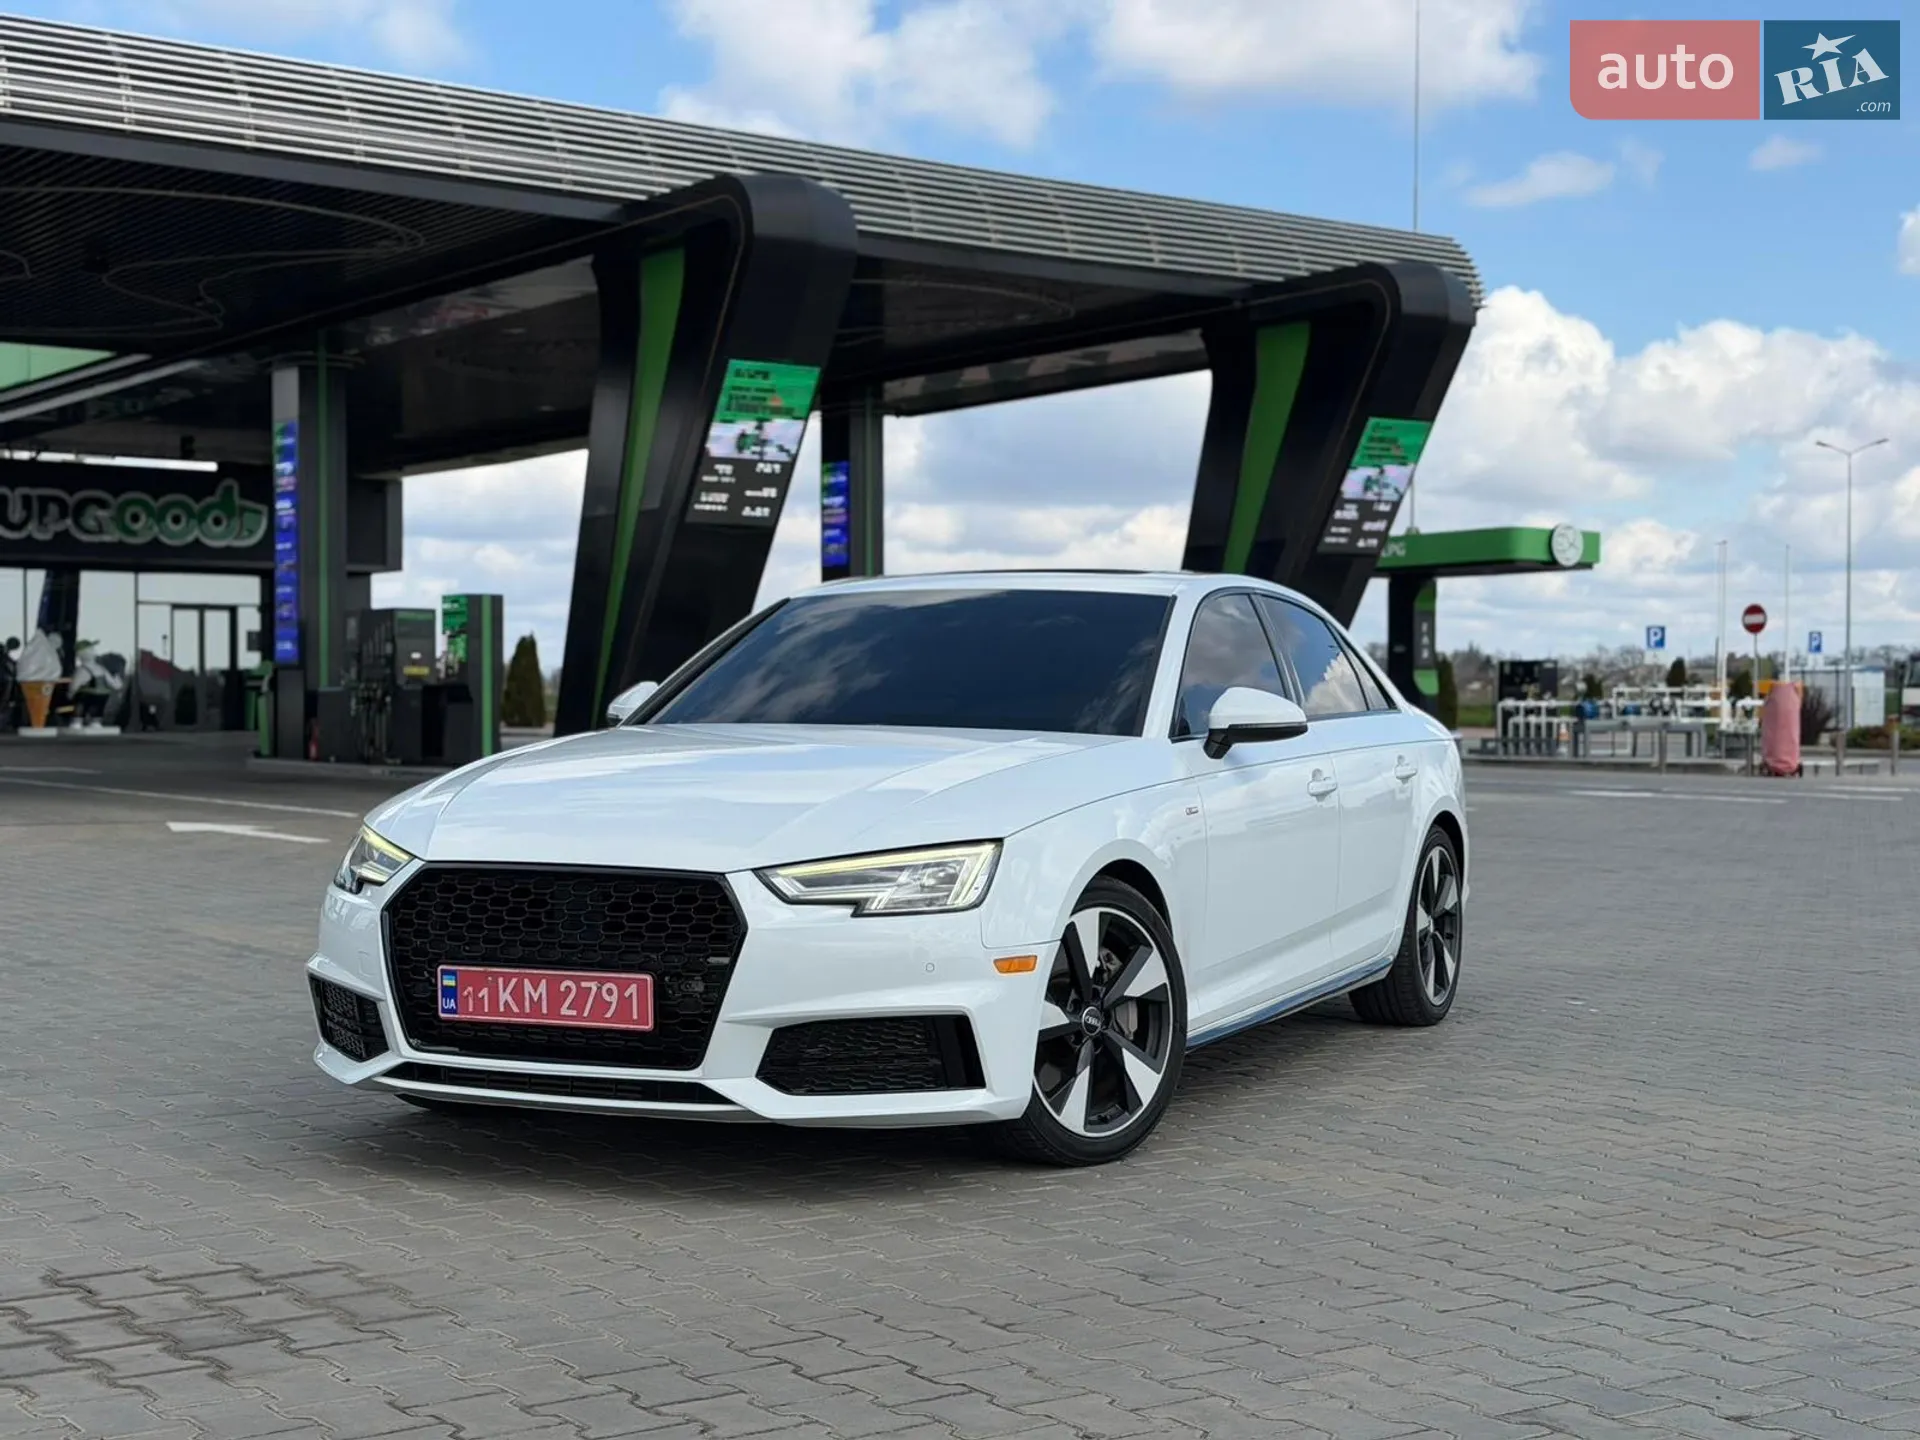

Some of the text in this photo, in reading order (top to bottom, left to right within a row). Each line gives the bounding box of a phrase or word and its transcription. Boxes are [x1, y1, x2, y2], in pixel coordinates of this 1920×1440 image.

[1649, 628, 1662, 648] P
[1811, 633, 1821, 652] P
[442, 994, 456, 1010] UA
[559, 979, 638, 1020] 2791
